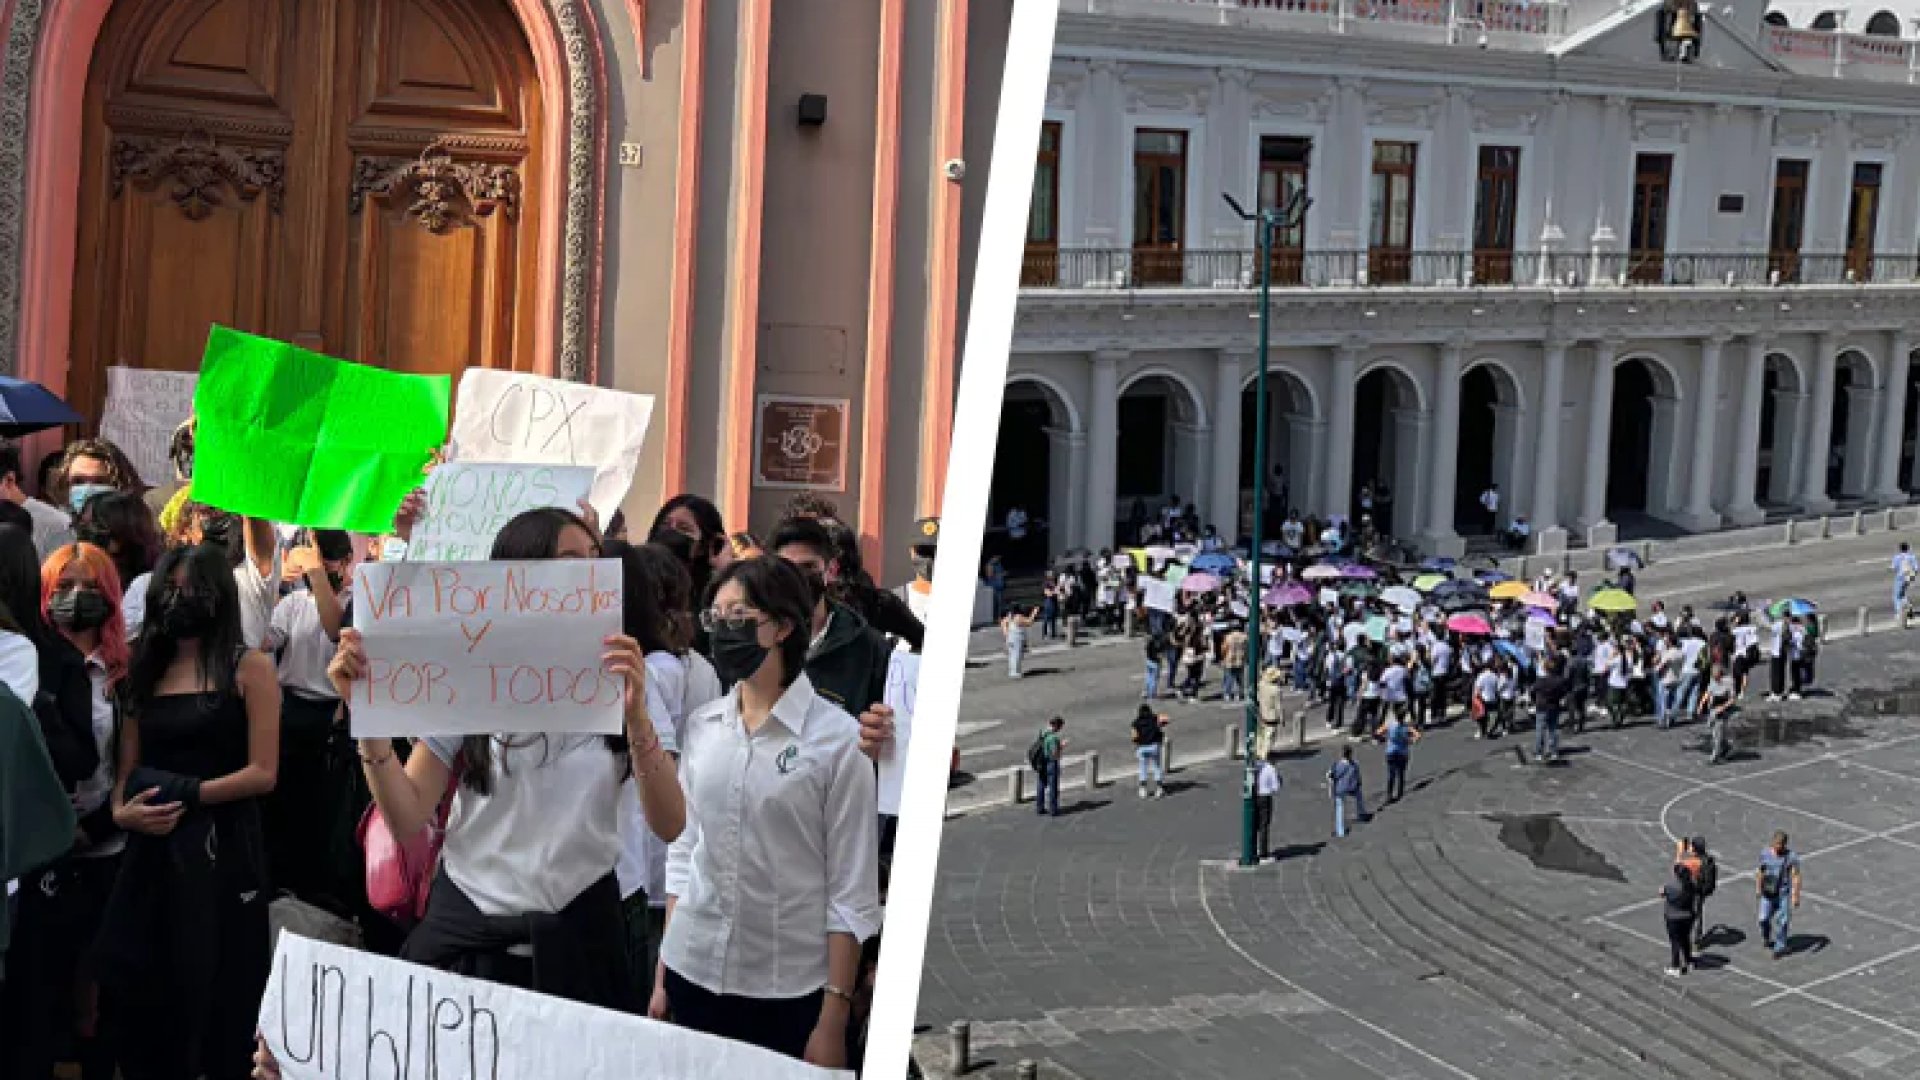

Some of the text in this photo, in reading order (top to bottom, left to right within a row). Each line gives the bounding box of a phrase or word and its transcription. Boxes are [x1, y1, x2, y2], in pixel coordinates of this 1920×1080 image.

[491, 384, 587, 466] CPX
[429, 467, 559, 519] NO NOS
[366, 657, 620, 706] POR TODOS
